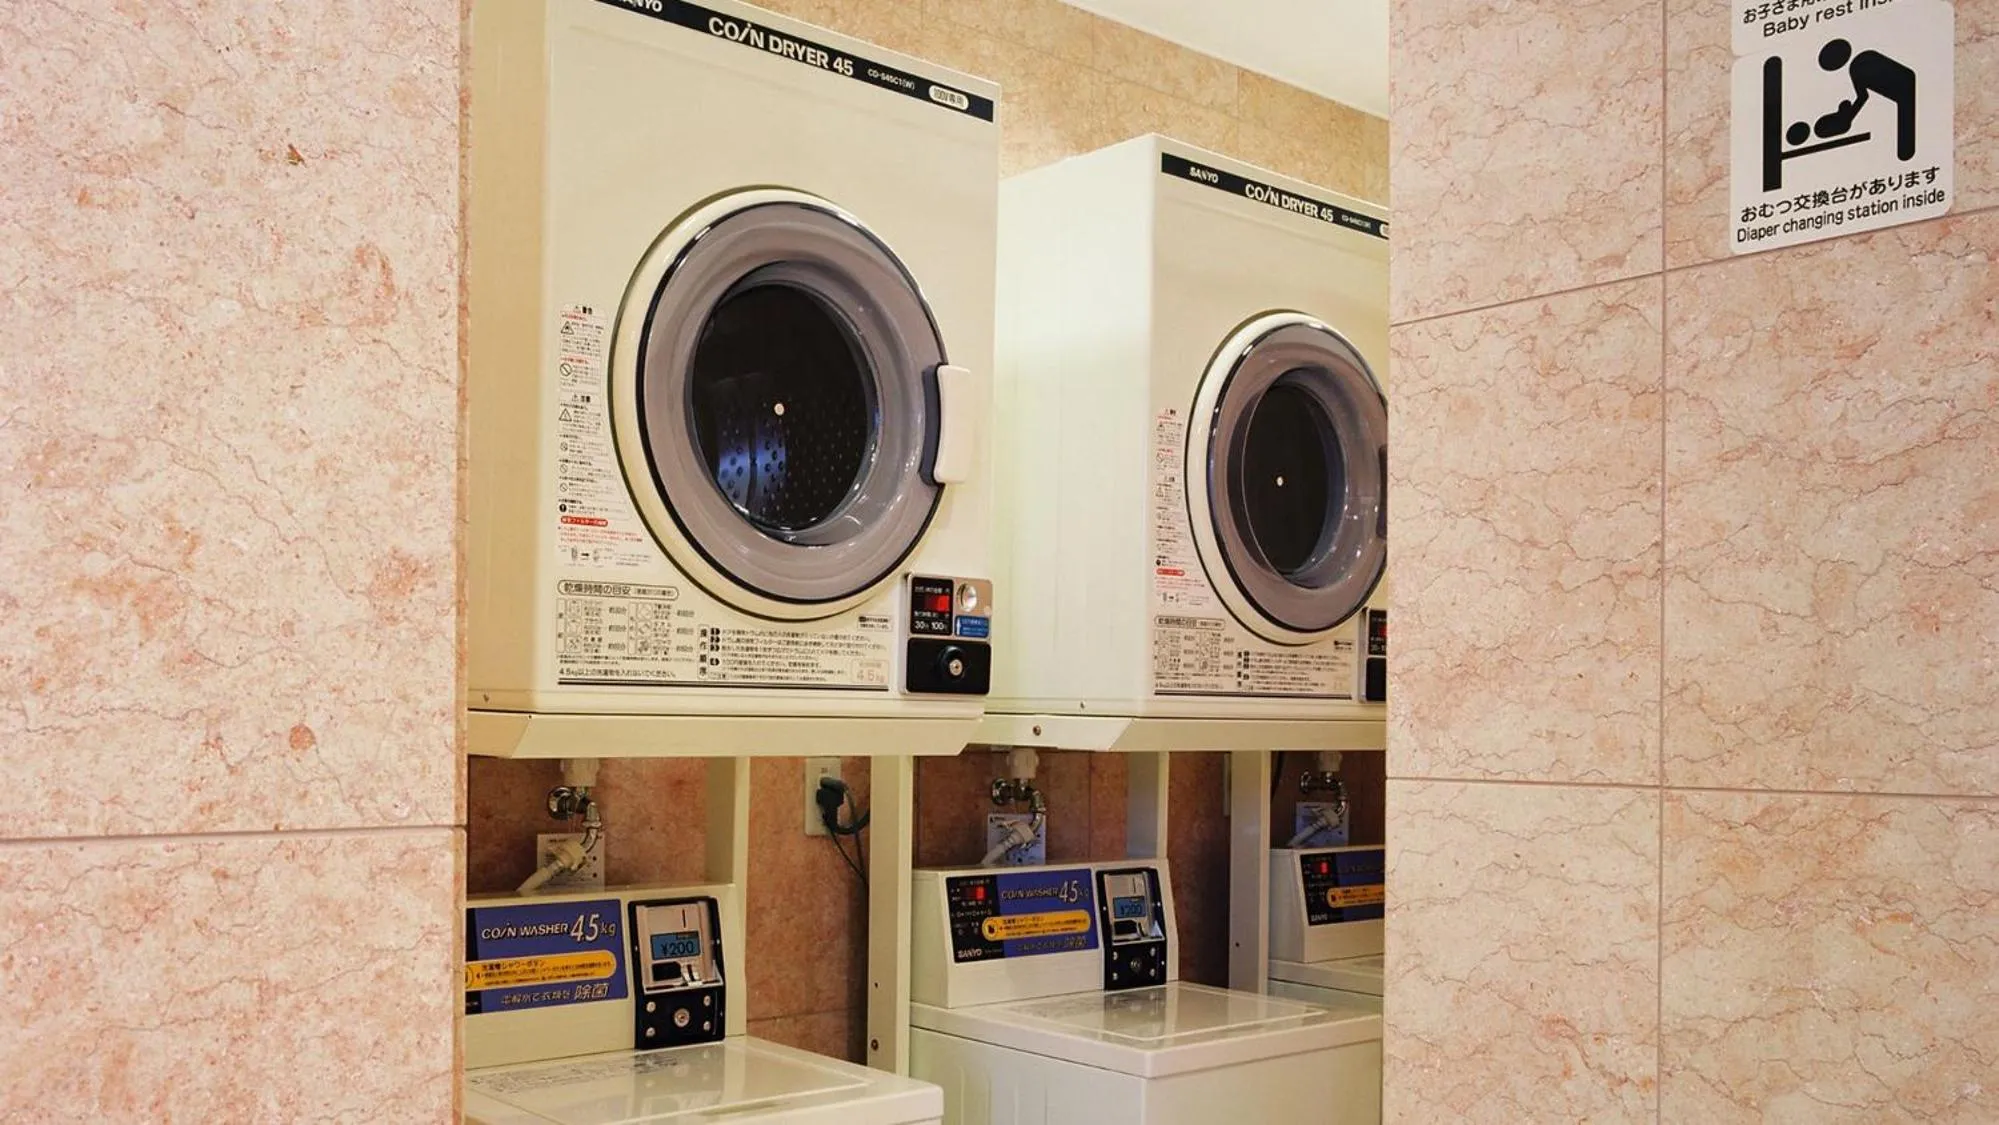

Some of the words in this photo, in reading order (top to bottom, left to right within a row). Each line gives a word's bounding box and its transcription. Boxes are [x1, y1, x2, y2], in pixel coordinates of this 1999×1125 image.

[1763, 14, 1810, 37] Baby
[1816, 2, 1854, 23] rest
[769, 34, 829, 70] DRYER
[832, 58, 854, 77] 45
[1189, 166, 1219, 184] SANYO
[1281, 194, 1318, 218] DRYER
[1320, 207, 1334, 223] 45
[1740, 166, 1941, 223] おむつ交換台があります
[1737, 222, 1779, 243] Diaper
[1783, 209, 1844, 234] changing
[1847, 196, 1899, 221] station
[1902, 187, 1946, 210] inside
[520, 922, 569, 936] WASHER
[660, 940, 694, 957] ¥200
[957, 948, 982, 958] SANYO
